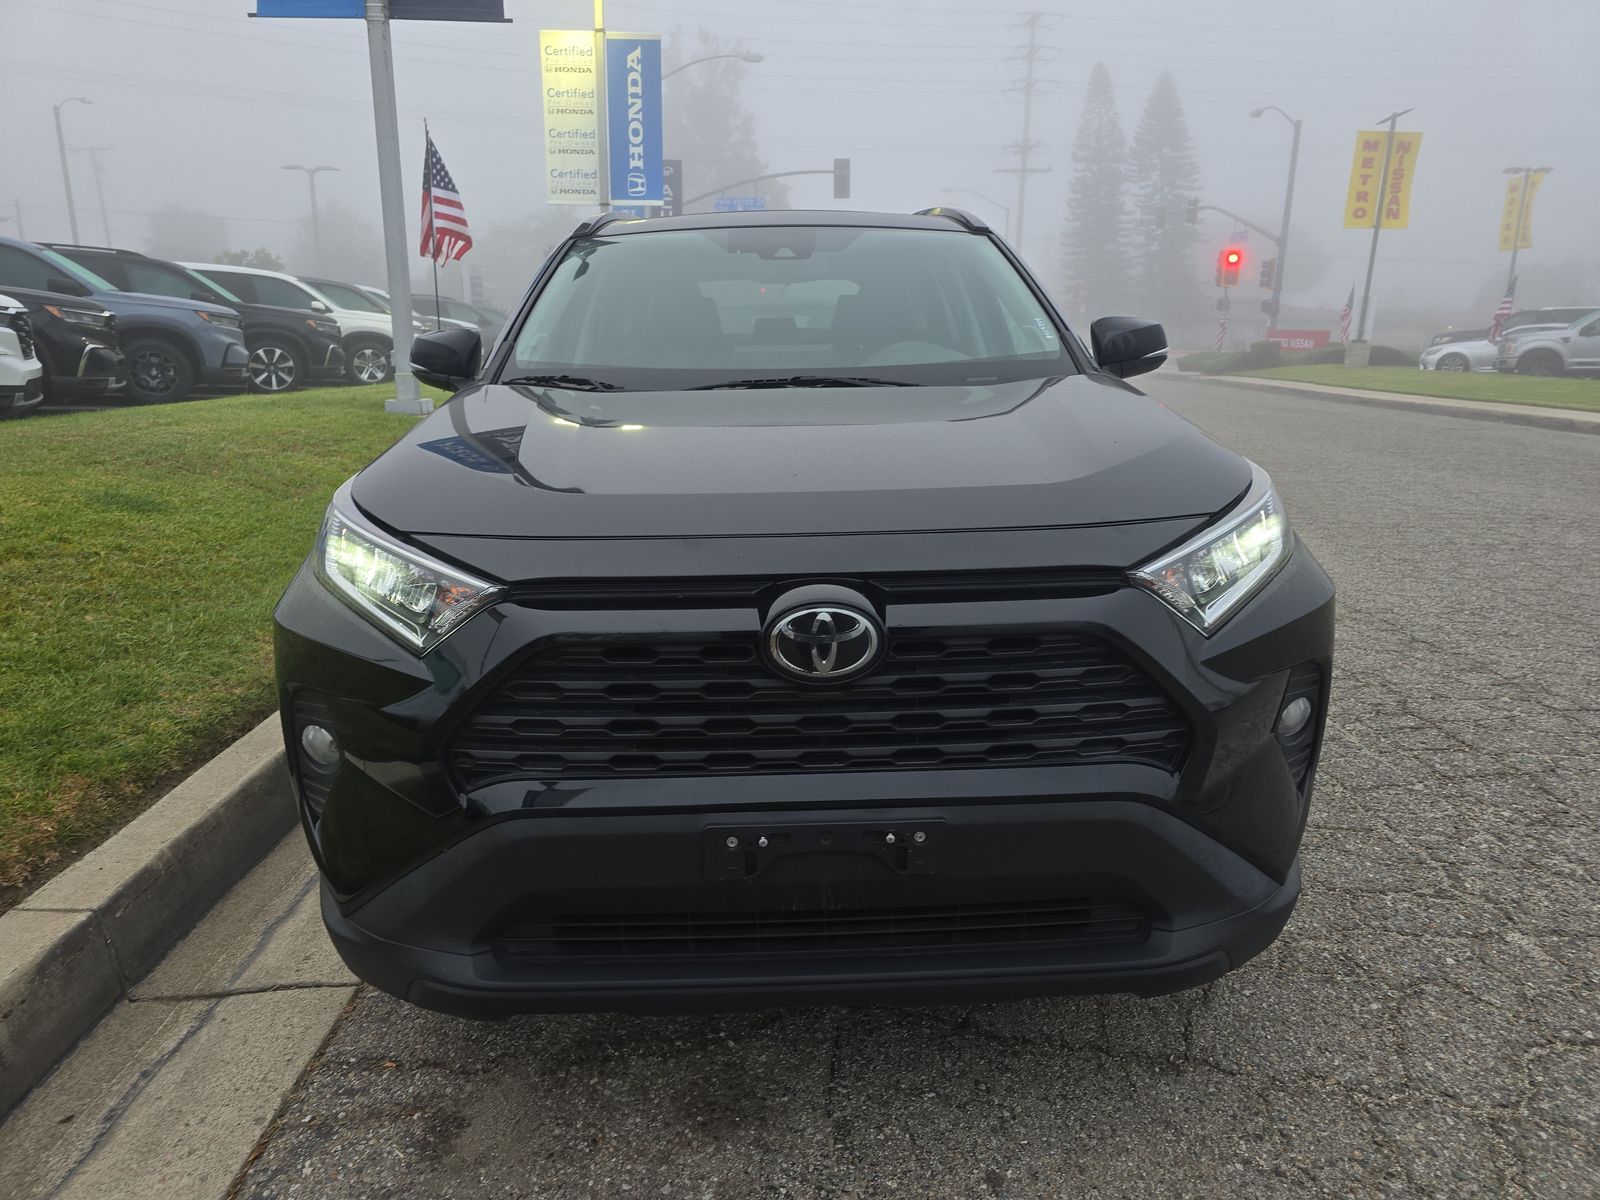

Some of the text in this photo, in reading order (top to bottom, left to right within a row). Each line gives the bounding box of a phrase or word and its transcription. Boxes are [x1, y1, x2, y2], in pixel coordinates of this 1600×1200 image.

[544, 45, 593, 57] Certified
[554, 66, 593, 74] HONDA
[546, 87, 594, 99] Certified
[626, 45, 645, 171] HONDA
[548, 128, 596, 139] Certified
[550, 168, 597, 179] Certified
[1352, 139, 1380, 220] METRO
[1385, 140, 1413, 220] NISSAN
